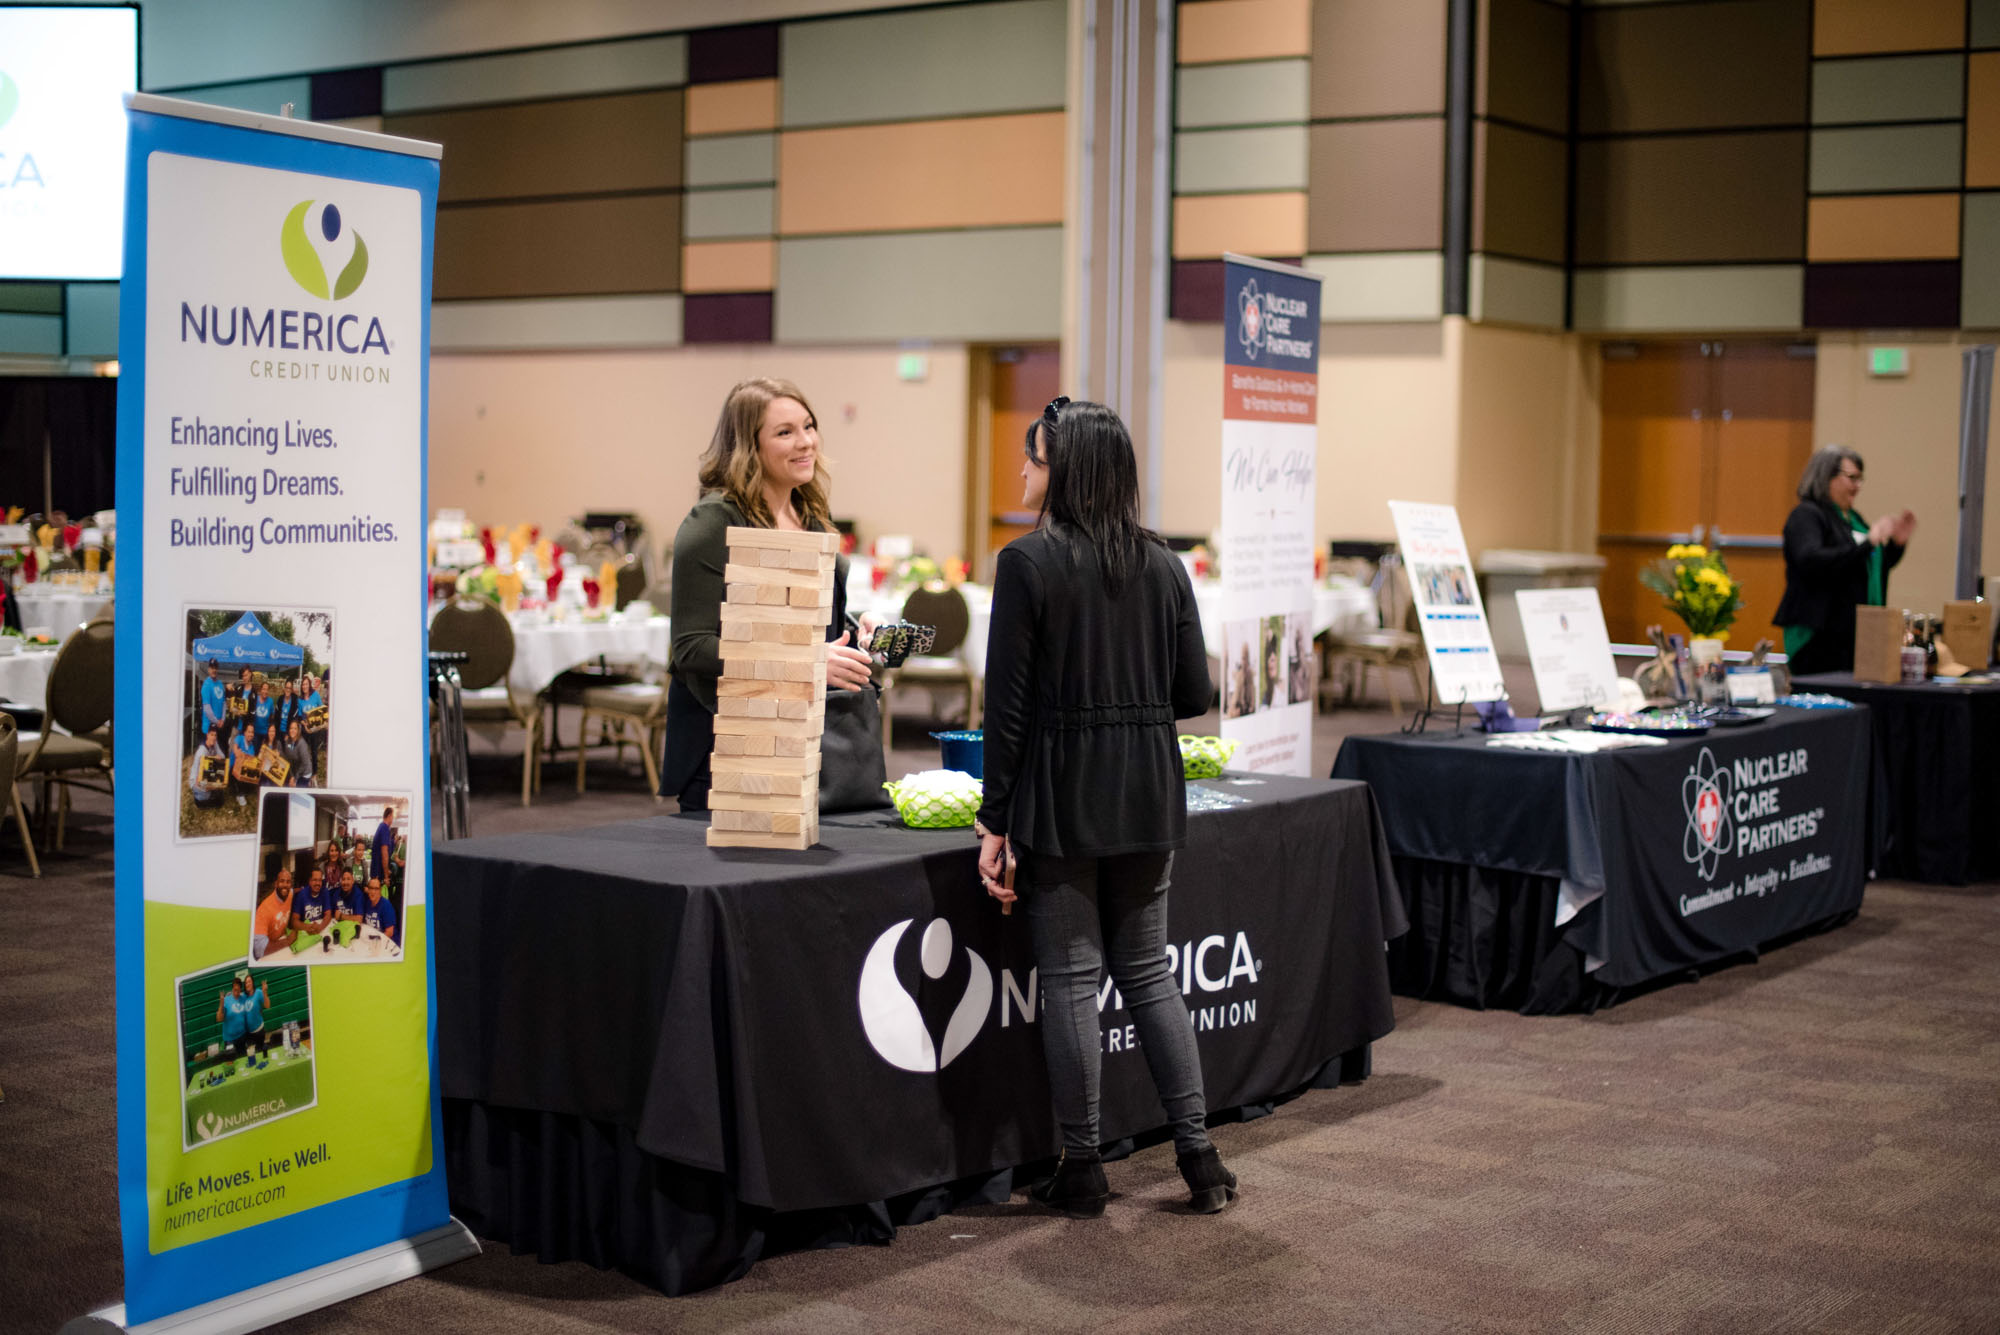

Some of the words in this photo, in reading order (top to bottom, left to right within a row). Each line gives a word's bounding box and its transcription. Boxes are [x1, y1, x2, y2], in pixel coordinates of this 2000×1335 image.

[181, 301, 391, 356] NUMERICA
[1266, 314, 1291, 335] CARE
[250, 360, 320, 380] CREDIT
[328, 364, 390, 384] UNION
[170, 416, 279, 455] Enhancing
[285, 419, 338, 448] Lives.
[170, 466, 257, 504] Fulfilling
[263, 468, 344, 496] Dreams.
[170, 517, 254, 554] Building
[260, 515, 398, 545] Communities.
[1734, 749, 1808, 790] NUCLEAR
[1735, 787, 1780, 822] CARE
[224, 1098, 286, 1128] NUMERICA
[166, 1182, 193, 1207] Life
[198, 1169, 255, 1196] Moves.
[259, 1158, 291, 1180] Live
[294, 1143, 331, 1169] Well.
[164, 1185, 286, 1233] numericacu.com
